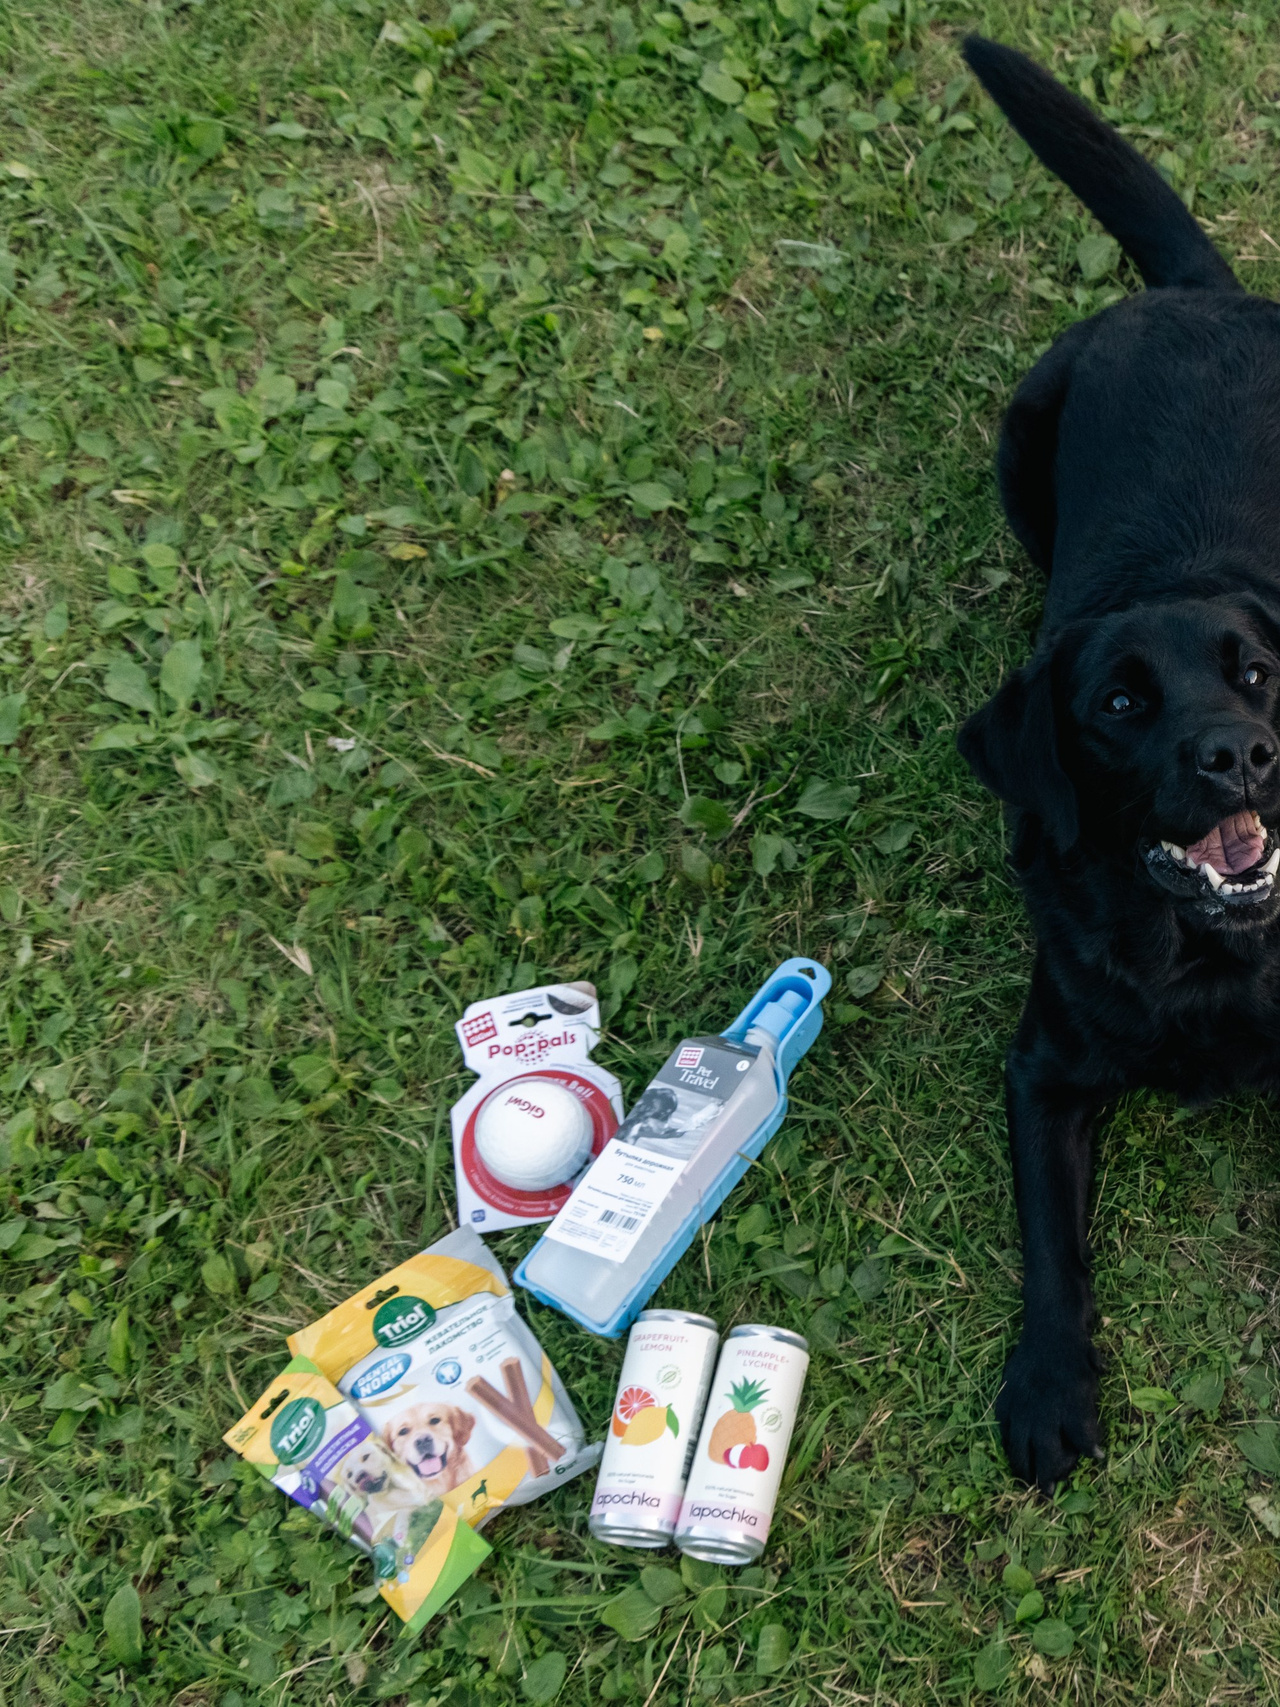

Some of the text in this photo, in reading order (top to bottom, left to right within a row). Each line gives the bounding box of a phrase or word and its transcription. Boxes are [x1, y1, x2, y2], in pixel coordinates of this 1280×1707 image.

[488, 1031, 576, 1059] Pop-pals
[679, 1069, 719, 1089] Travel
[696, 1066, 712, 1077] Pet
[568, 1080, 595, 1098] Ball
[614, 1148, 674, 1171] Бутылка дорожная
[616, 1174, 634, 1185] 750
[378, 1302, 426, 1339] Triol
[425, 1304, 487, 1346] ЖЕВАТЕЛЬНОЕ
[428, 1317, 484, 1355] ЛАКОМСТВО
[640, 1344, 673, 1352] LEMON
[358, 1355, 401, 1386] DENTAL
[743, 1359, 779, 1372] LYCHEE
[361, 1364, 405, 1398] NORM
[277, 1406, 316, 1452] Triol
[689, 1503, 758, 1526] lapochka
